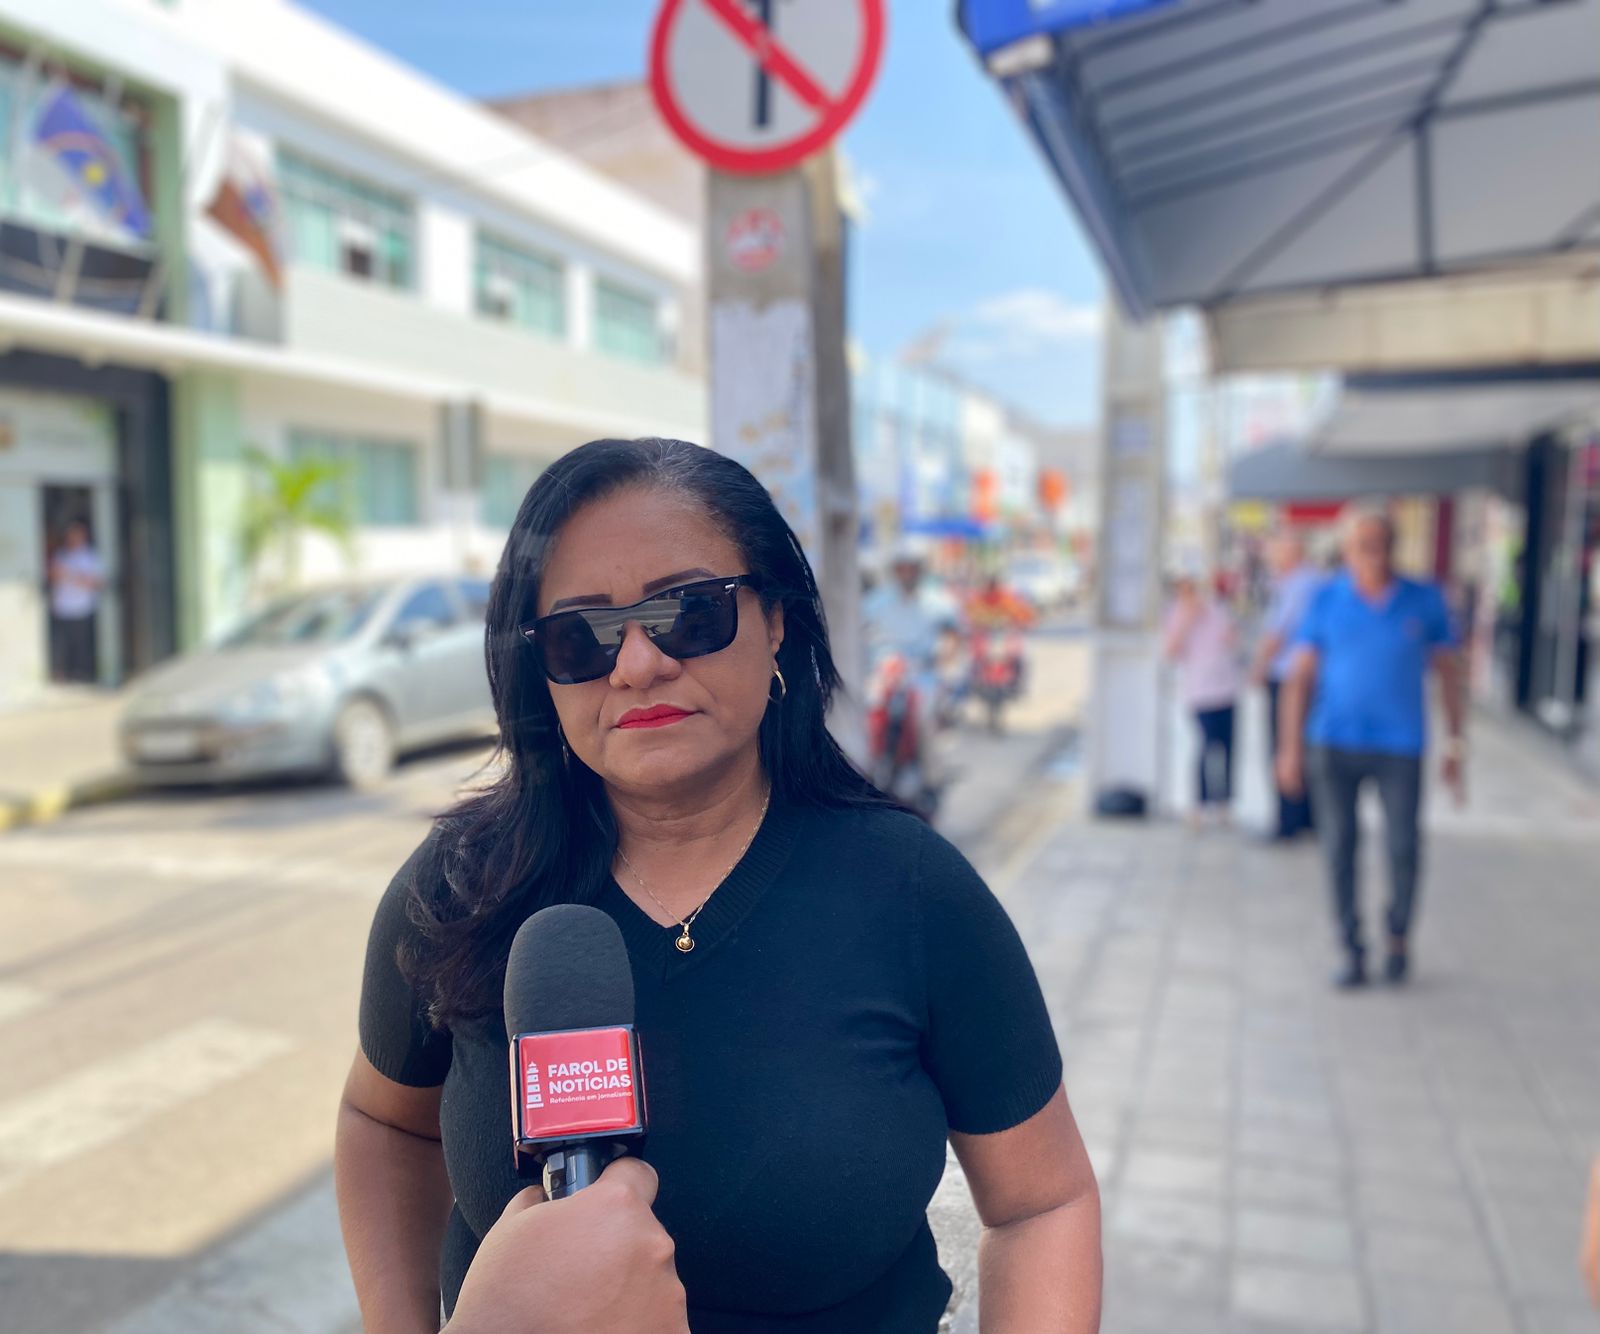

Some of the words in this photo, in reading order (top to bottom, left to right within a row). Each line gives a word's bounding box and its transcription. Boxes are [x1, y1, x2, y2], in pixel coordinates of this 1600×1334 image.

[547, 1060, 603, 1078] FAROL
[606, 1058, 628, 1073] DE
[549, 1074, 632, 1095] NOTÍCIAS
[549, 1095, 586, 1104] Referência
